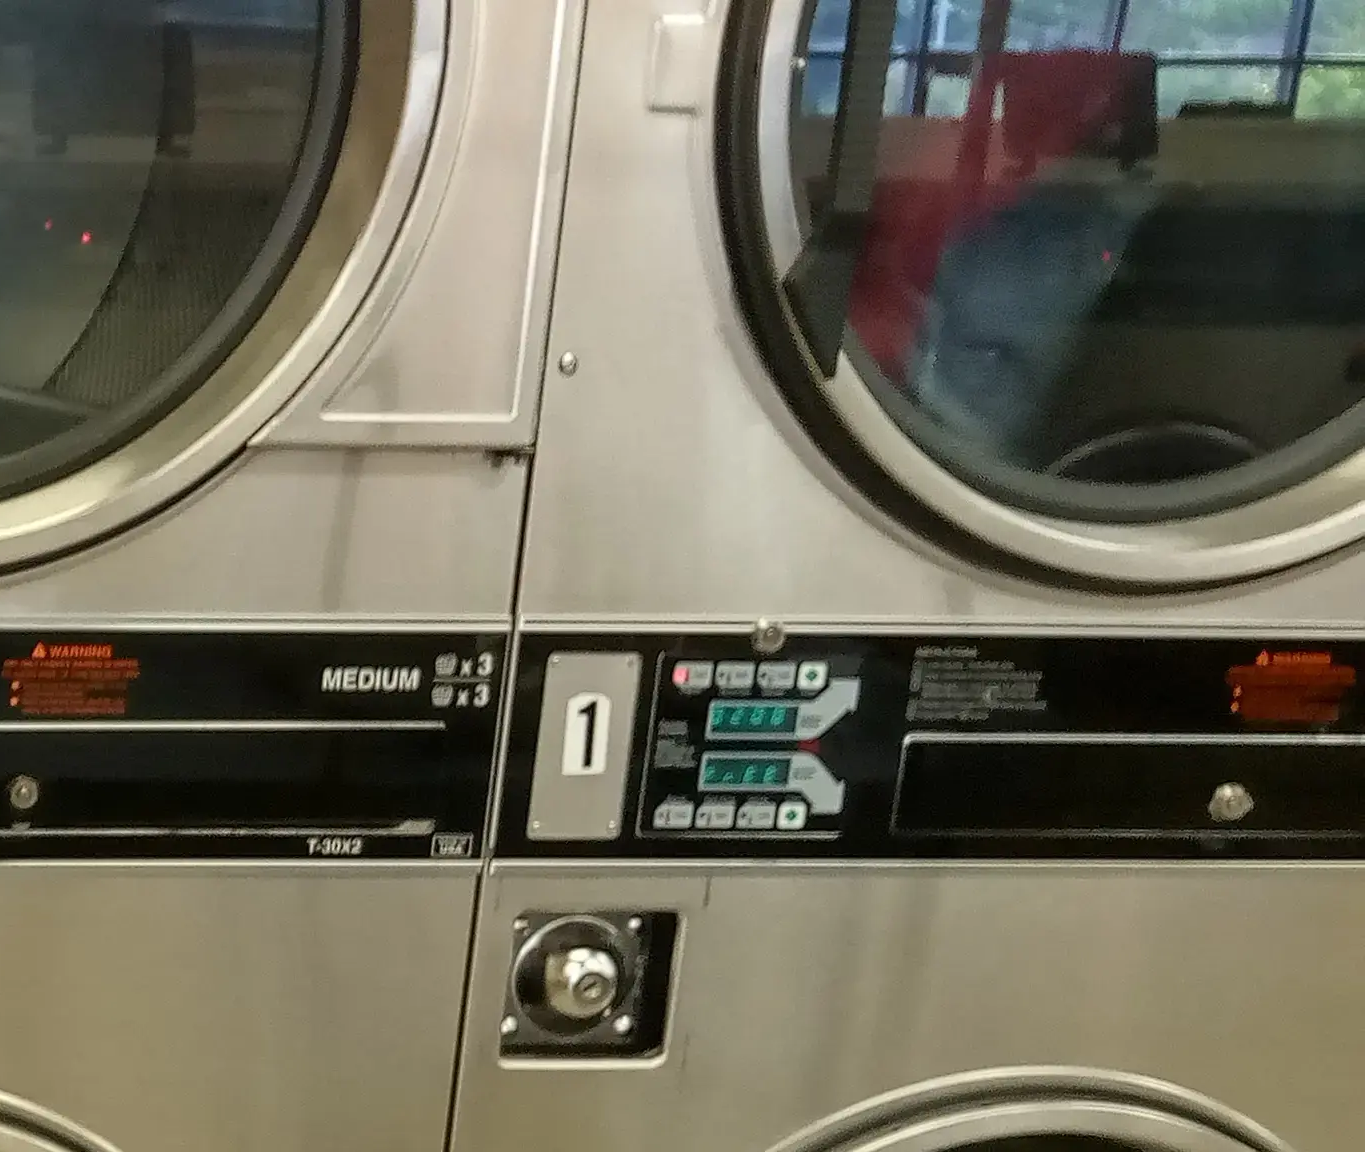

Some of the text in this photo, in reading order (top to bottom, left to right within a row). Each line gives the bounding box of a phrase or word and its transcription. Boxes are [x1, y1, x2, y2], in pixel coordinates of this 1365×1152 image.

[49, 644, 113, 658] WARNING
[476, 651, 494, 677] 3
[321, 666, 422, 692] MEDIUM
[473, 682, 491, 707] 3
[576, 699, 598, 769] 1
